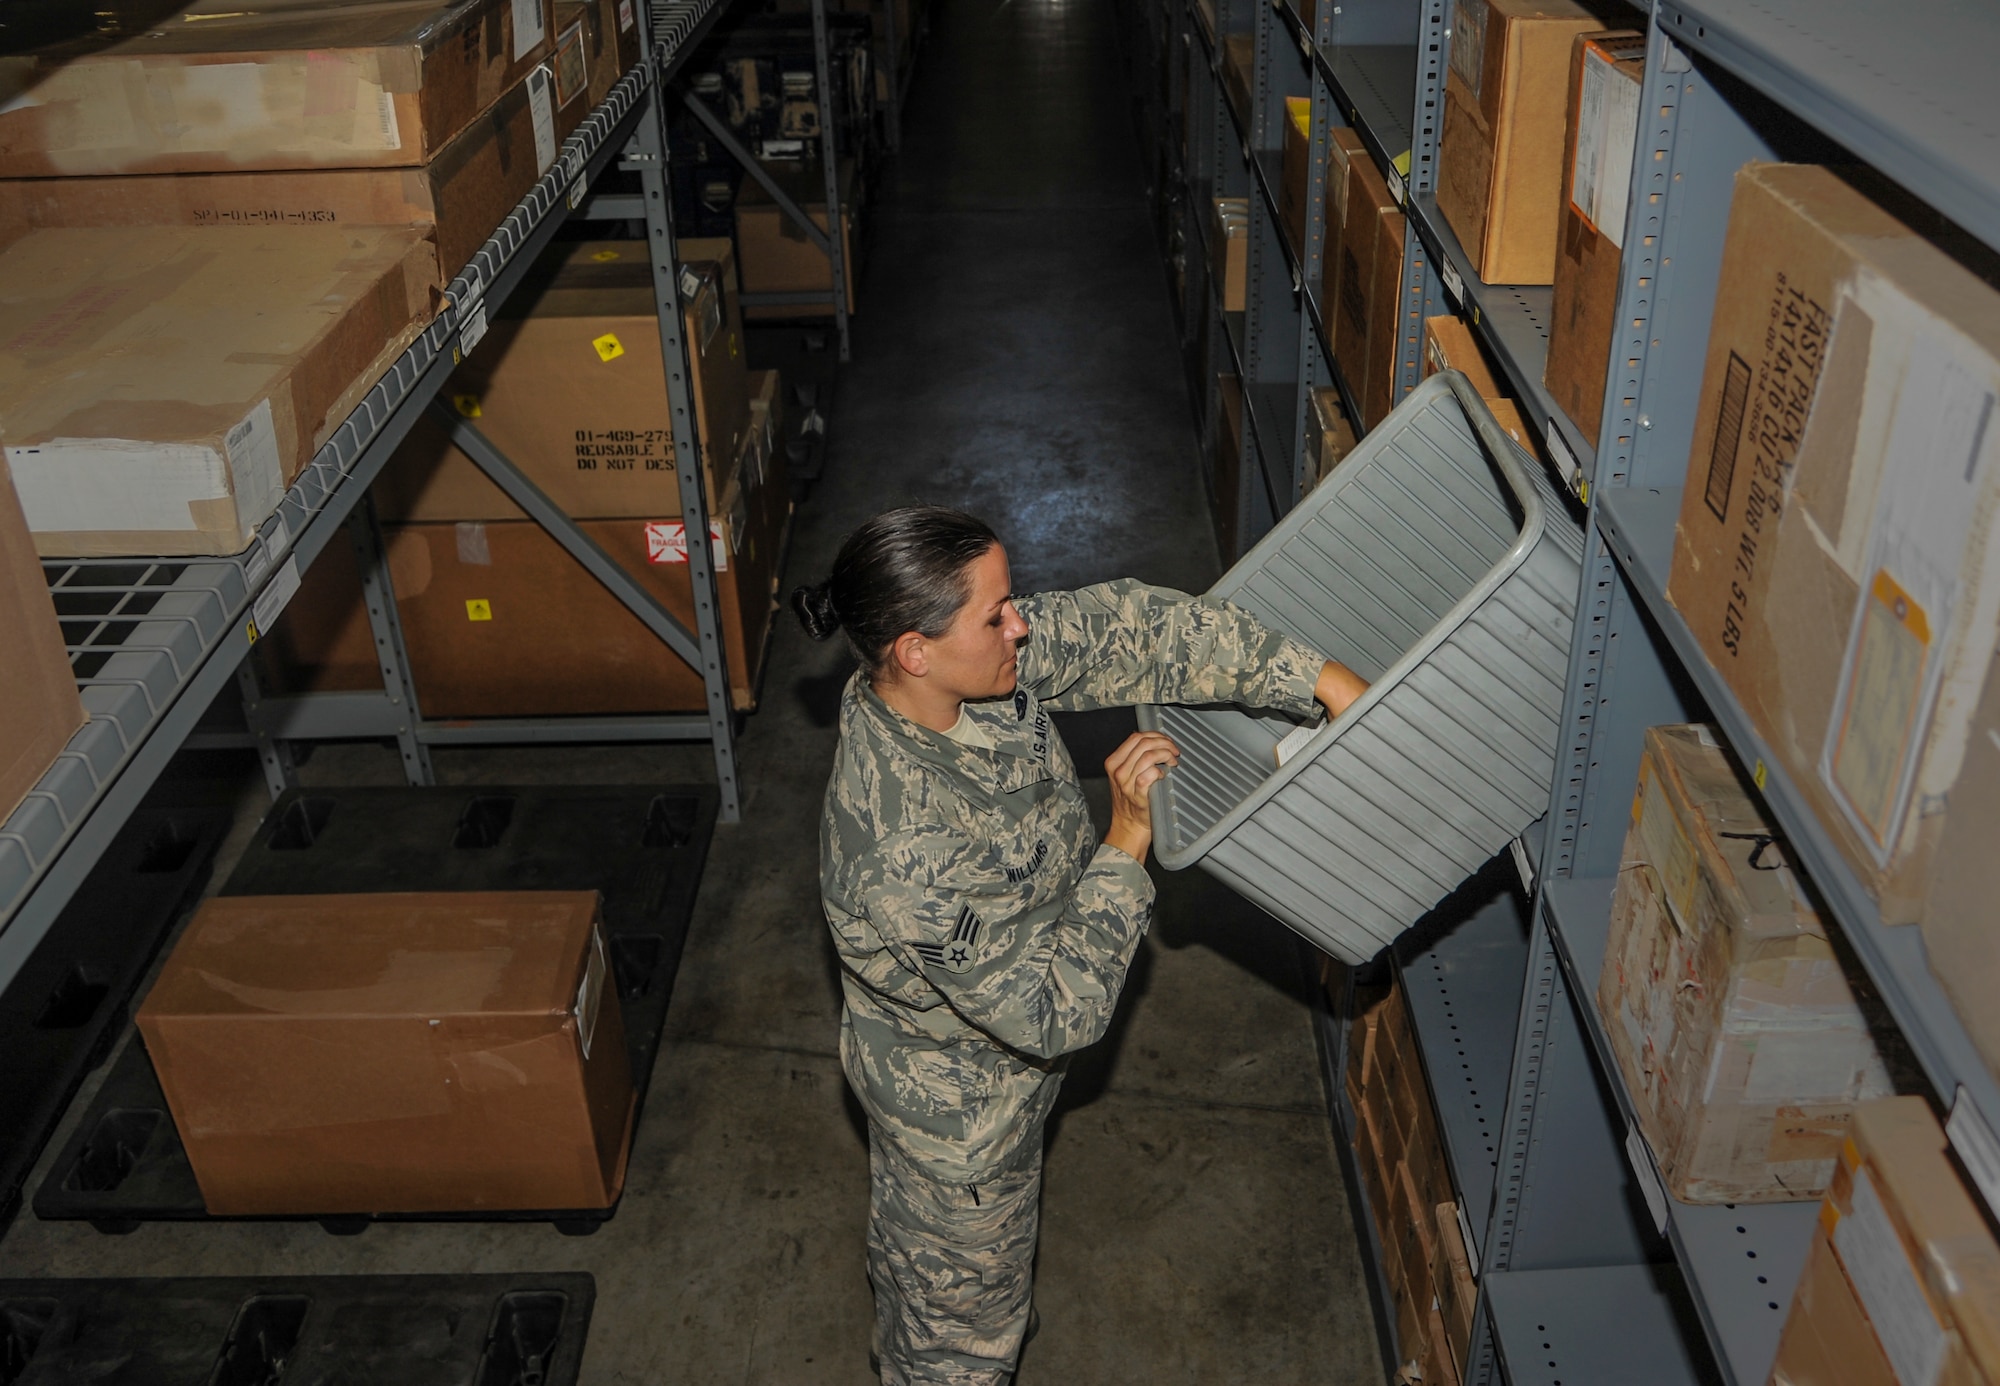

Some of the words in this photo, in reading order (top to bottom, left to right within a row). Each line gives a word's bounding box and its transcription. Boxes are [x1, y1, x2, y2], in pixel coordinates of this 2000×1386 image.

[1798, 298, 1827, 379] FAST
[1760, 413, 1780, 458] CU
[1780, 374, 1810, 456] PACK
[575, 444, 654, 456] REUSABLE
[577, 458, 598, 470] DO
[606, 458, 636, 470] NOT
[1745, 453, 1772, 534] 2.008
[650, 538, 687, 547] FRAGILE
[1735, 531, 1758, 582] WT.
[1732, 580, 1748, 608] 5
[1722, 601, 1744, 658] LBS
[1034, 717, 1048, 740] AIR
[1004, 838, 1049, 884] WILLIAMS
